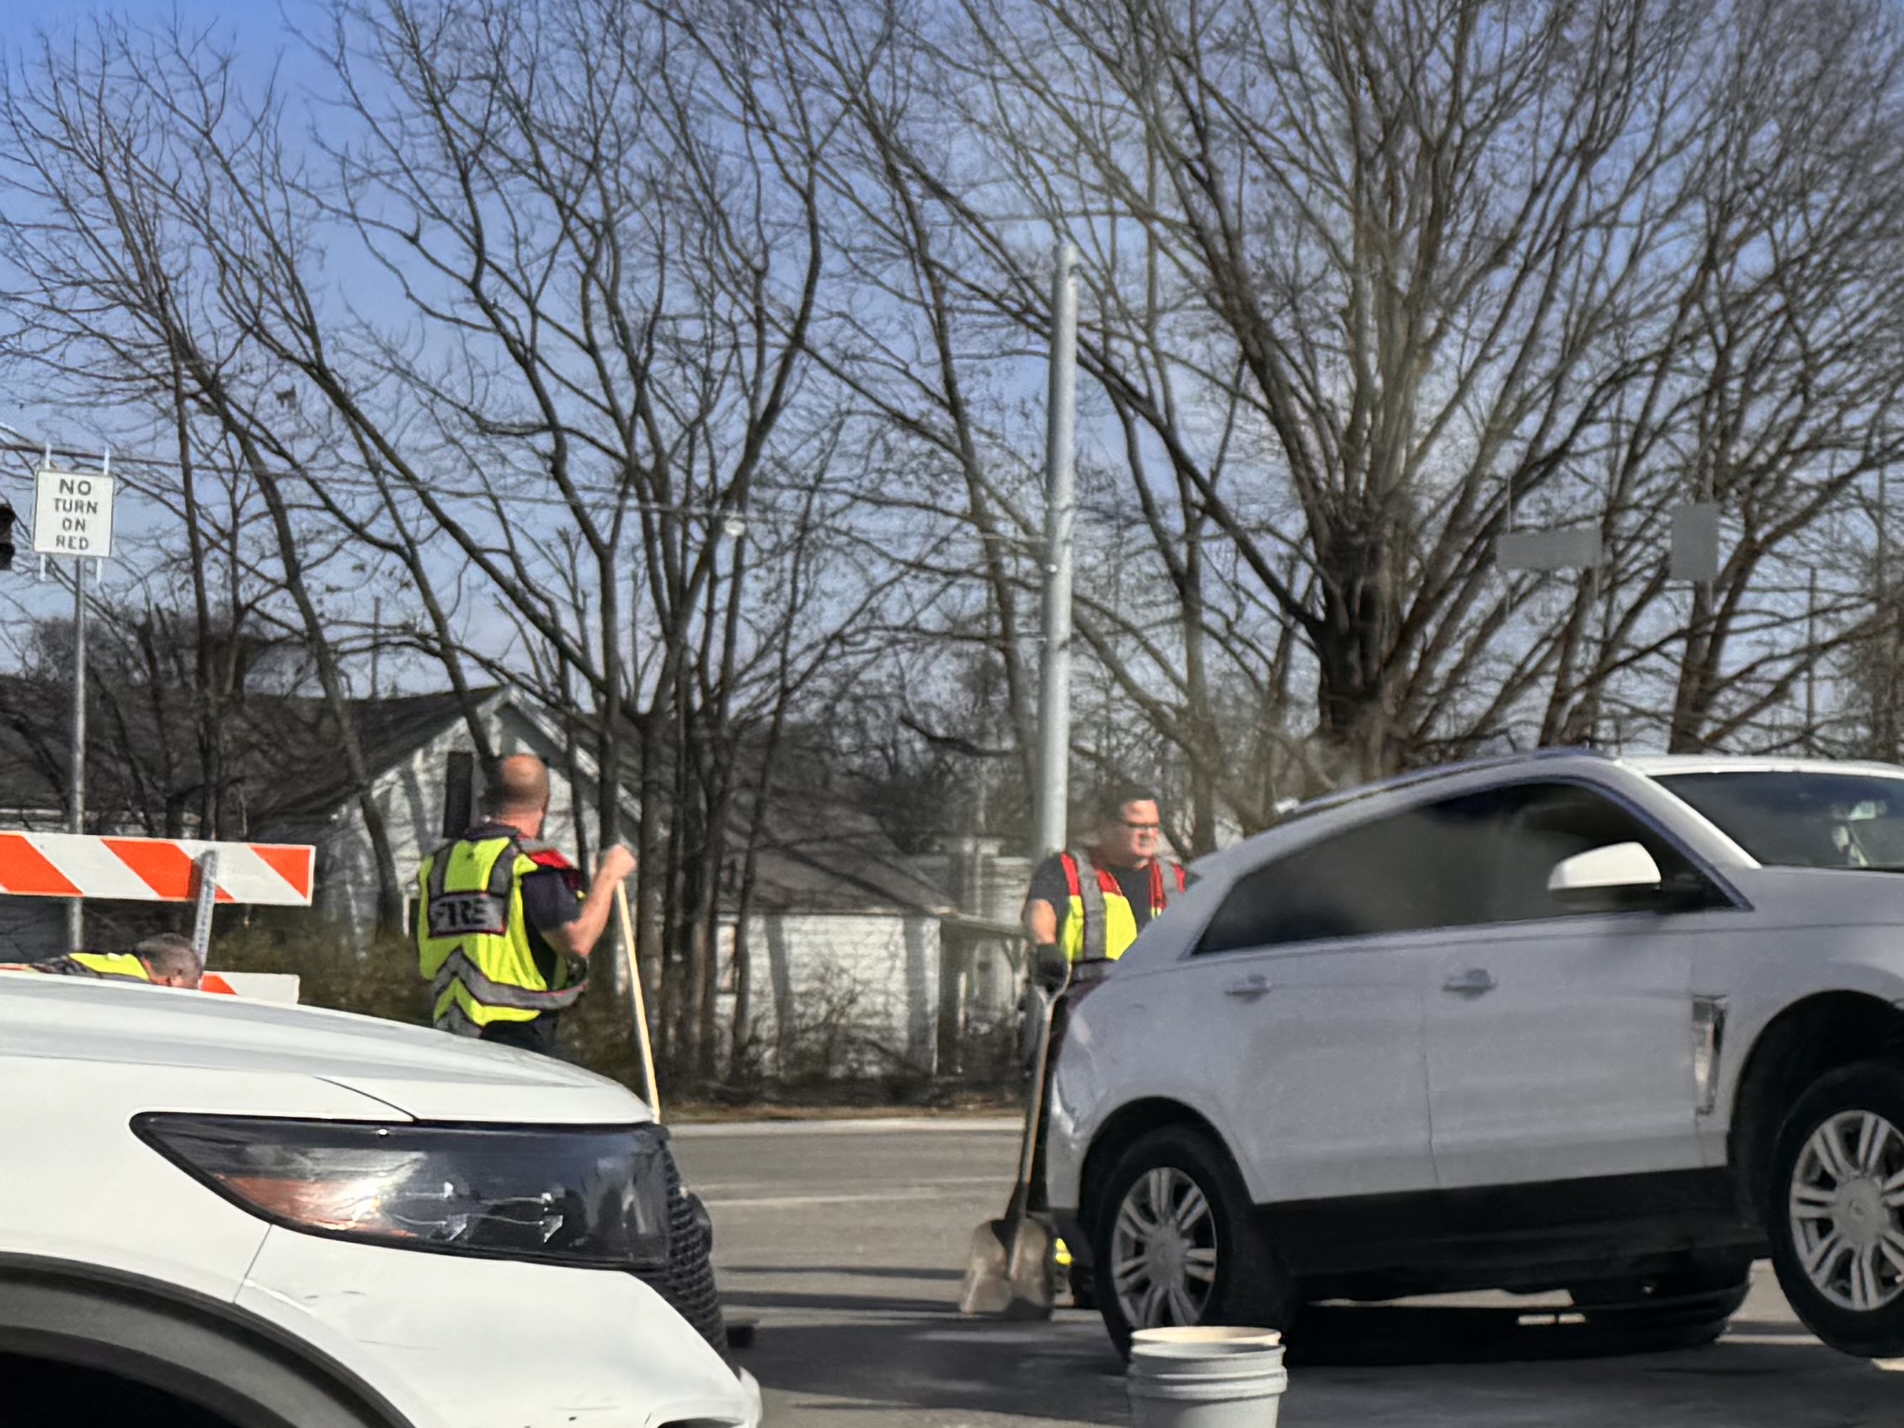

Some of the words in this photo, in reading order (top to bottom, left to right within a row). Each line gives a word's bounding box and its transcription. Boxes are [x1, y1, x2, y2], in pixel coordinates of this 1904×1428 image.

[59, 477, 92, 496] NO
[54, 497, 98, 515] TURN
[62, 517, 86, 533] ON
[55, 534, 89, 550] RED
[434, 898, 488, 926] FIRE
